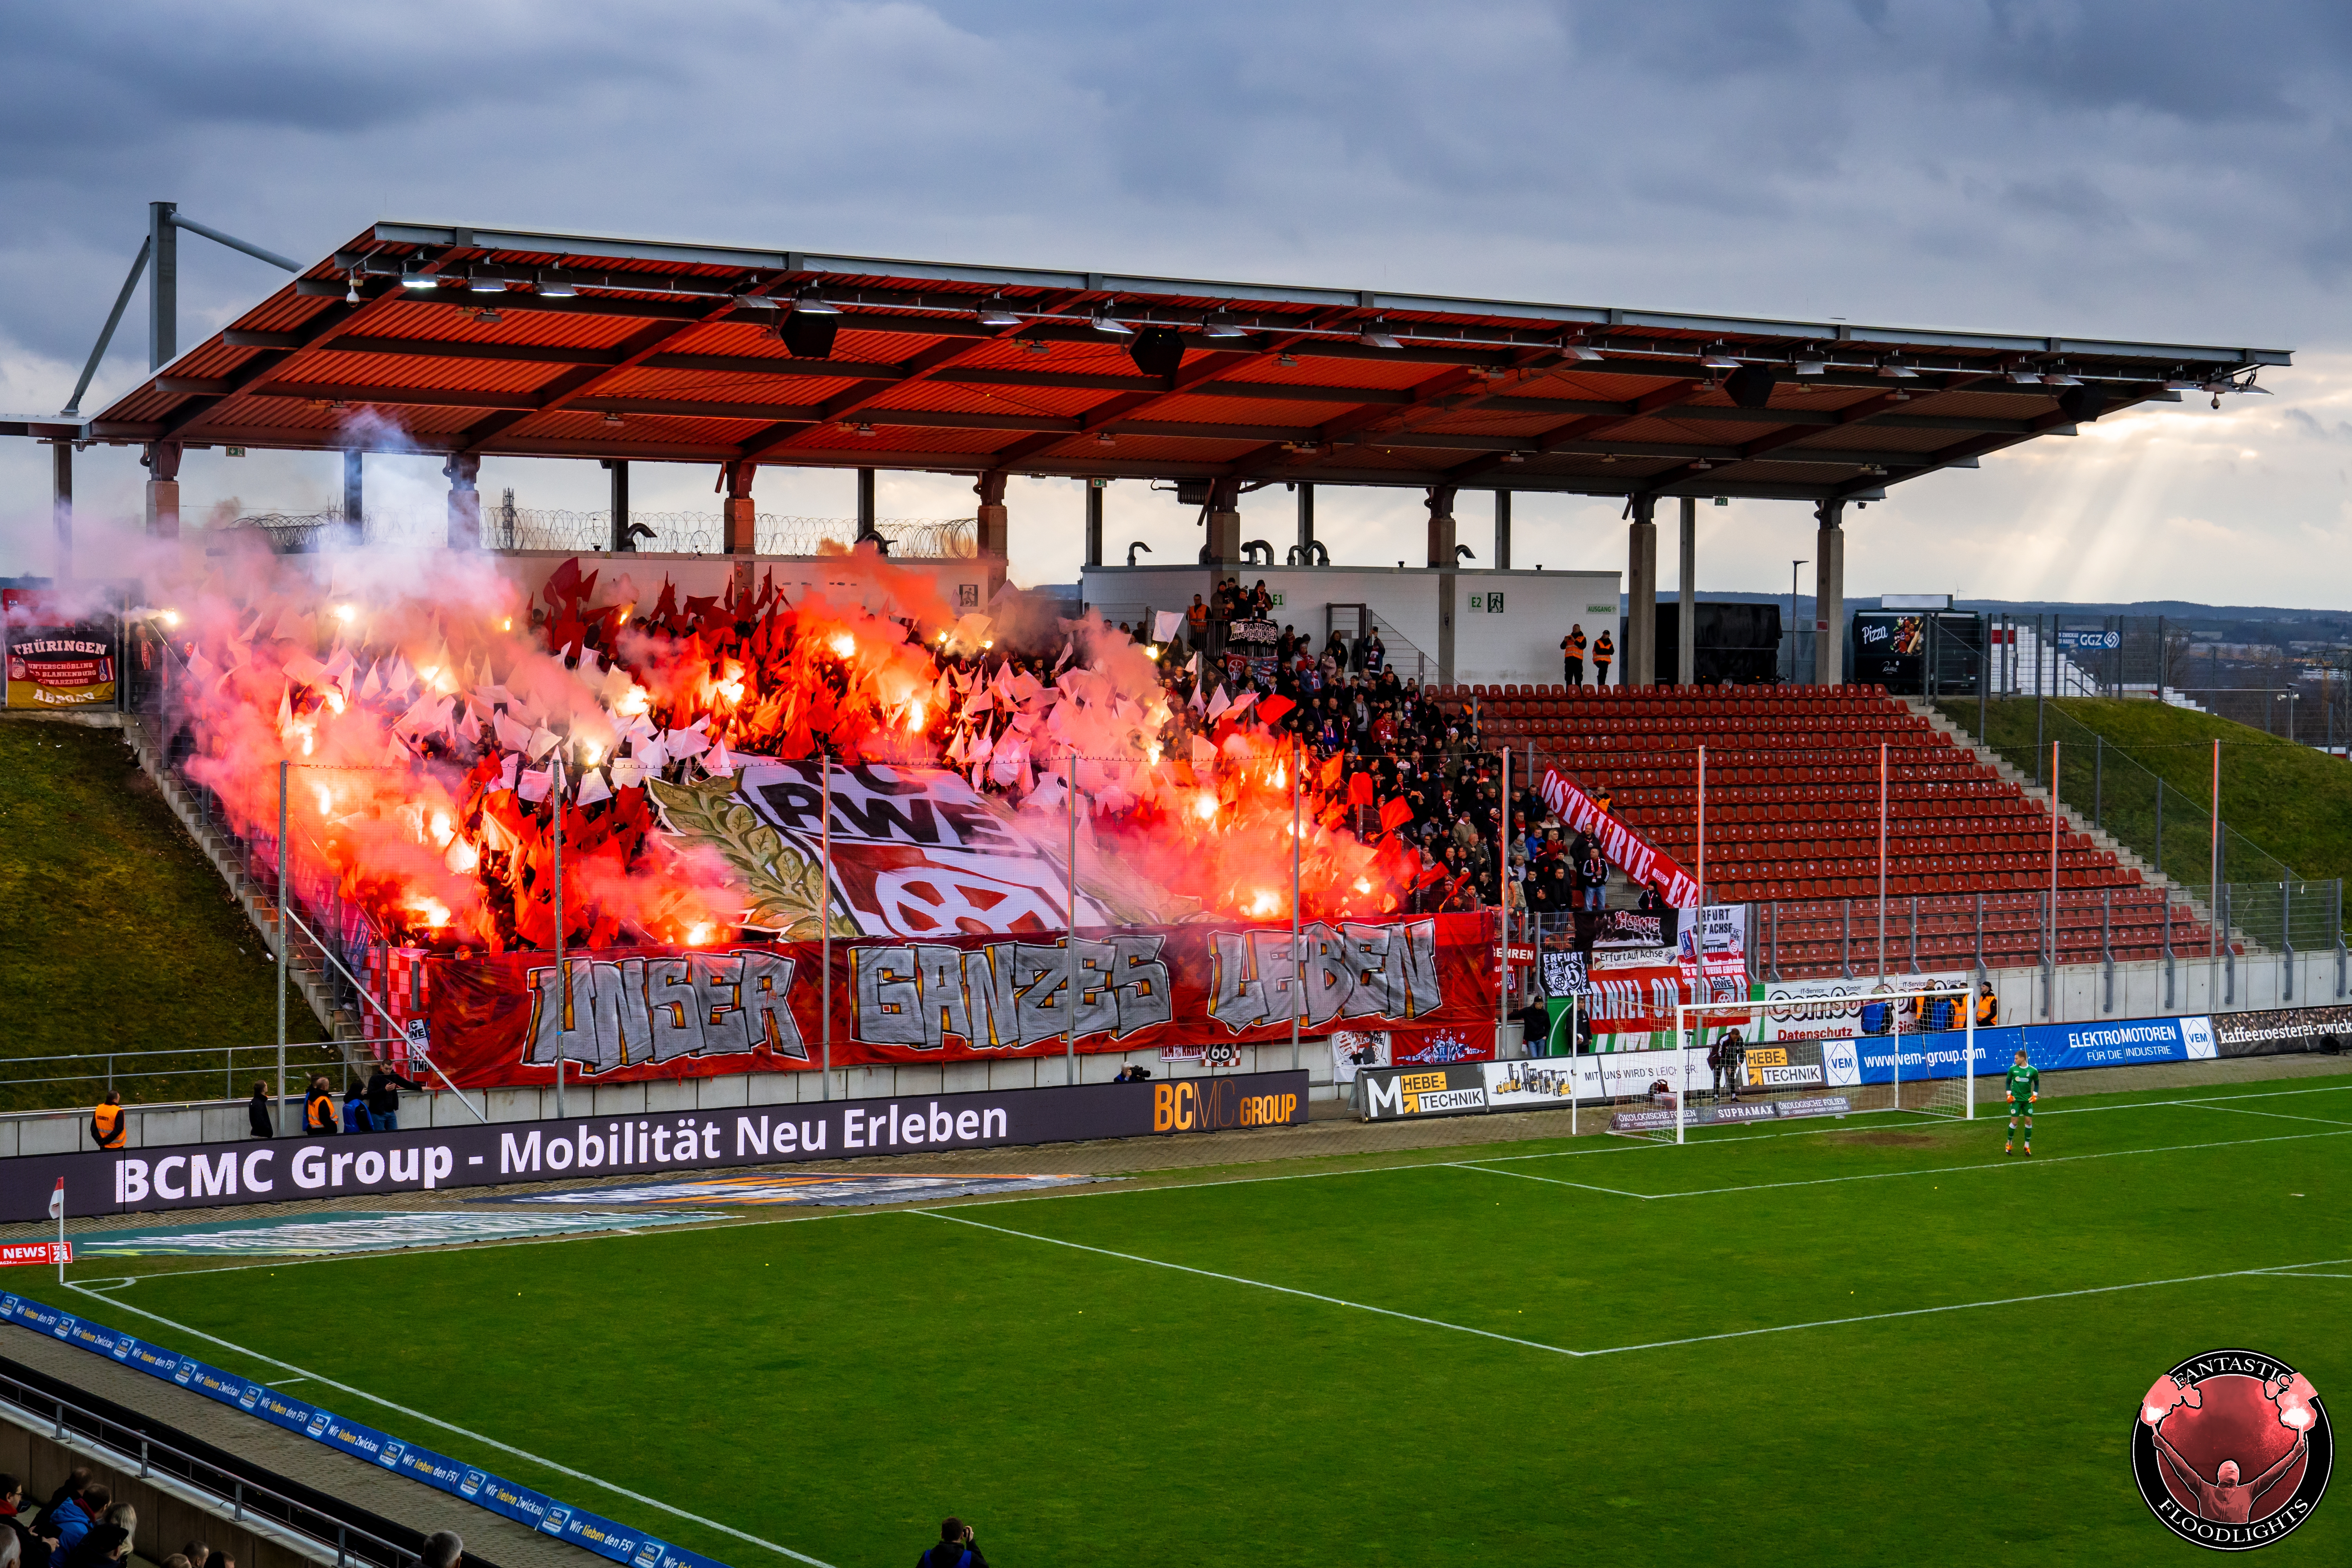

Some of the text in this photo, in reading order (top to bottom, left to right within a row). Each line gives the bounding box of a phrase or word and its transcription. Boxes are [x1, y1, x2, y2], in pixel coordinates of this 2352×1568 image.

[1273, 594, 1283, 605] E1
[1472, 597, 1481, 608] E2
[1243, 623, 1270, 632] BANDA
[1862, 625, 1887, 644] Pizza
[1229, 630, 1277, 641] ALCOHOLICA
[2080, 634, 2103, 646] GGZ
[11, 639, 107, 655] THÜRINGEN
[757, 782, 1020, 846] RWE
[1693, 924, 1707, 935] AF
[1543, 952, 1584, 963] ERFURT
[1599, 949, 1663, 962] Erfurt Auf Achse
[1207, 918, 1443, 1036] LEBEN
[1550, 967, 1563, 976] RWE
[1705, 966, 1722, 975] WEISS
[1723, 965, 1745, 973] ERFURT
[1713, 980, 1734, 989] RWE
[848, 935, 1173, 1050] GANZES
[1650, 977, 1680, 1018] ON
[521, 949, 809, 1076] UNSER
[1778, 1026, 1853, 1041] Datenschutz
[2068, 1026, 2176, 1048] ELEKTROMOTOREN
[2188, 1033, 2209, 1043] VEM
[1211, 1044, 1230, 1059] 66
[1747, 1049, 1786, 1064] HEBE-
[2087, 1045, 2172, 1061] FÜR DIE INDUSTRIE
[1832, 1058, 1853, 1069] VEM
[1585, 1071, 1599, 1081] MIT
[1604, 1070, 1621, 1080] UNS
[1764, 1064, 1820, 1084] TECHNIK
[1403, 1075, 1445, 1091] HEBE-
[1154, 1079, 1297, 1132] BCMC GROUP
[1421, 1091, 1483, 1109] TECHNIK
[1778, 1098, 1846, 1110] ÖKOLOGISCHE FOLIEN
[1618, 1111, 1670, 1122] ÖKOLOGISCHE
[1719, 1105, 1774, 1118] SUPRAMAX
[116, 1102, 1007, 1203] BCMC Group - Mobilität Neu Erleben
[3, 1247, 46, 1259] NEWS
[16, 1305, 25, 1315] Wir
[37, 1313, 47, 1324] den
[45, 1316, 57, 1326] FSV
[72, 1326, 82, 1337] Wir
[80, 1329, 96, 1343] lieben
[94, 1335, 115, 1349] Zwickau
[131, 1347, 142, 1357] Wir
[140, 1350, 156, 1364] lieben
[154, 1357, 165, 1368] den
[164, 1359, 177, 1370] FSV
[194, 1372, 205, 1383] Wir
[203, 1376, 220, 1390] lieben
[218, 1382, 240, 1397] Zwickau
[260, 1396, 271, 1408] Wir
[269, 1400, 287, 1415] lieben
[285, 1408, 296, 1419] den
[295, 1411, 309, 1423] FSV
[327, 1425, 339, 1437] Wir
[338, 1429, 357, 1444] lieben
[354, 1436, 379, 1453] Zwickau
[402, 1453, 416, 1466] Wir
[414, 1458, 434, 1474] lieben
[432, 1466, 446, 1479] den
[445, 1470, 460, 1483] FSV
[465, 1478, 479, 1488] Zwickau
[485, 1483, 498, 1496] Wir
[496, 1488, 517, 1505] lieben
[515, 1496, 544, 1516] Zwickau
[547, 1515, 563, 1525] Zwickau
[552, 1510, 563, 1518] Radio
[569, 1519, 584, 1534] Wir
[581, 1524, 605, 1542] lieben
[604, 1534, 620, 1548] den
[618, 1538, 636, 1553] FSV
[639, 1550, 655, 1561] Zwickau
[644, 1544, 655, 1553] Radio
